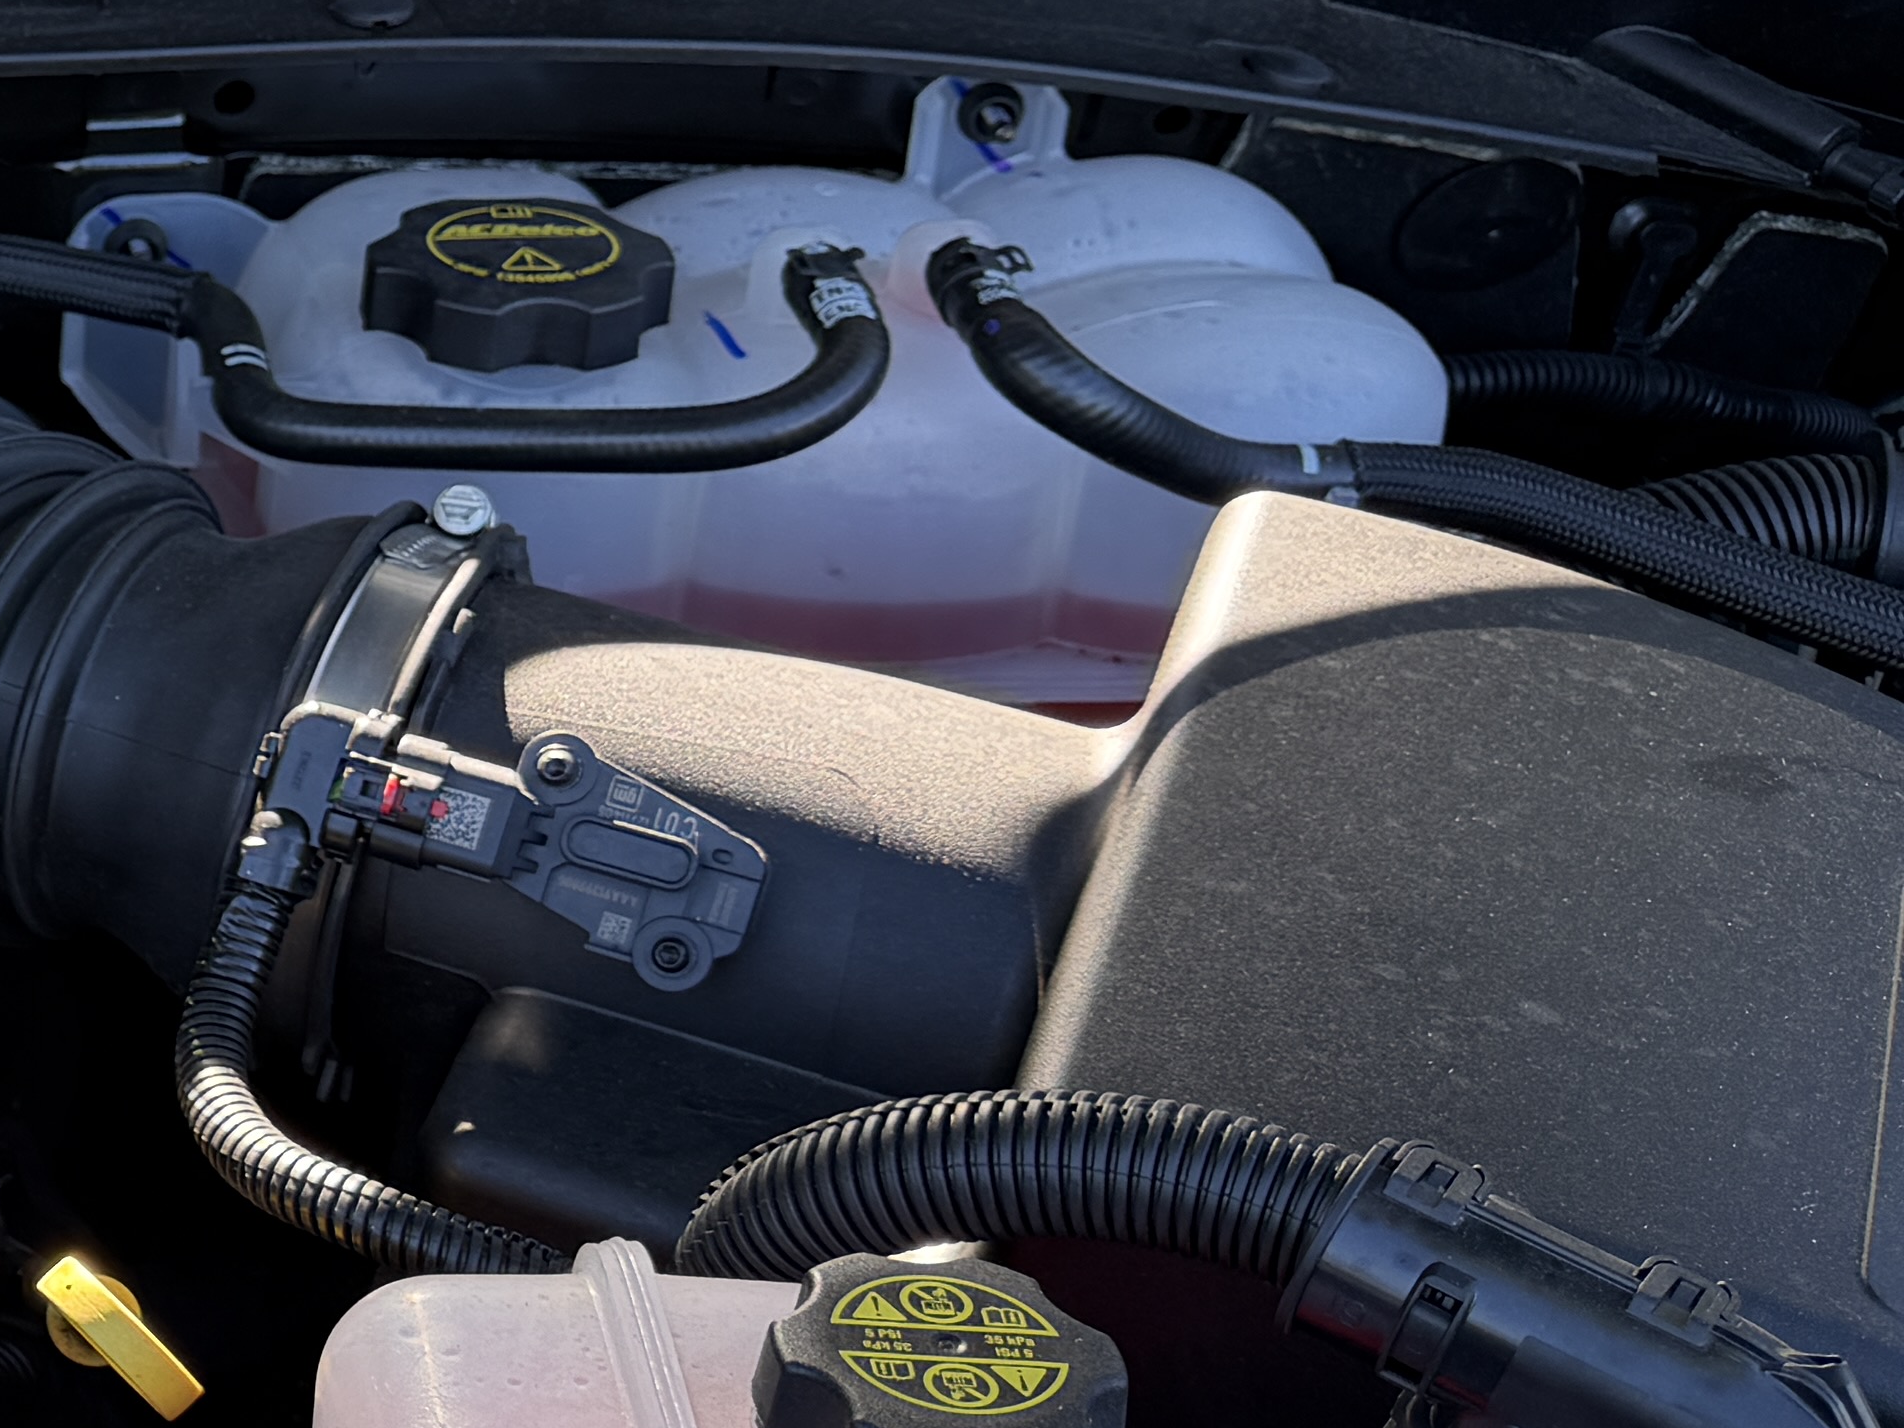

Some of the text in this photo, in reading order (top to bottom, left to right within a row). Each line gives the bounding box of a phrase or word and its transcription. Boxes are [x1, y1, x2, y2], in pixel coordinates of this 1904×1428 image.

[439, 224, 601, 239] ACDelco
[654, 807, 699, 838] C01
[864, 1328, 902, 1339] 5 PSI
[863, 1340, 913, 1351] 35 kPa
[983, 1334, 1036, 1347] 35 kPa
[995, 1346, 1035, 1359] 5 PSI
